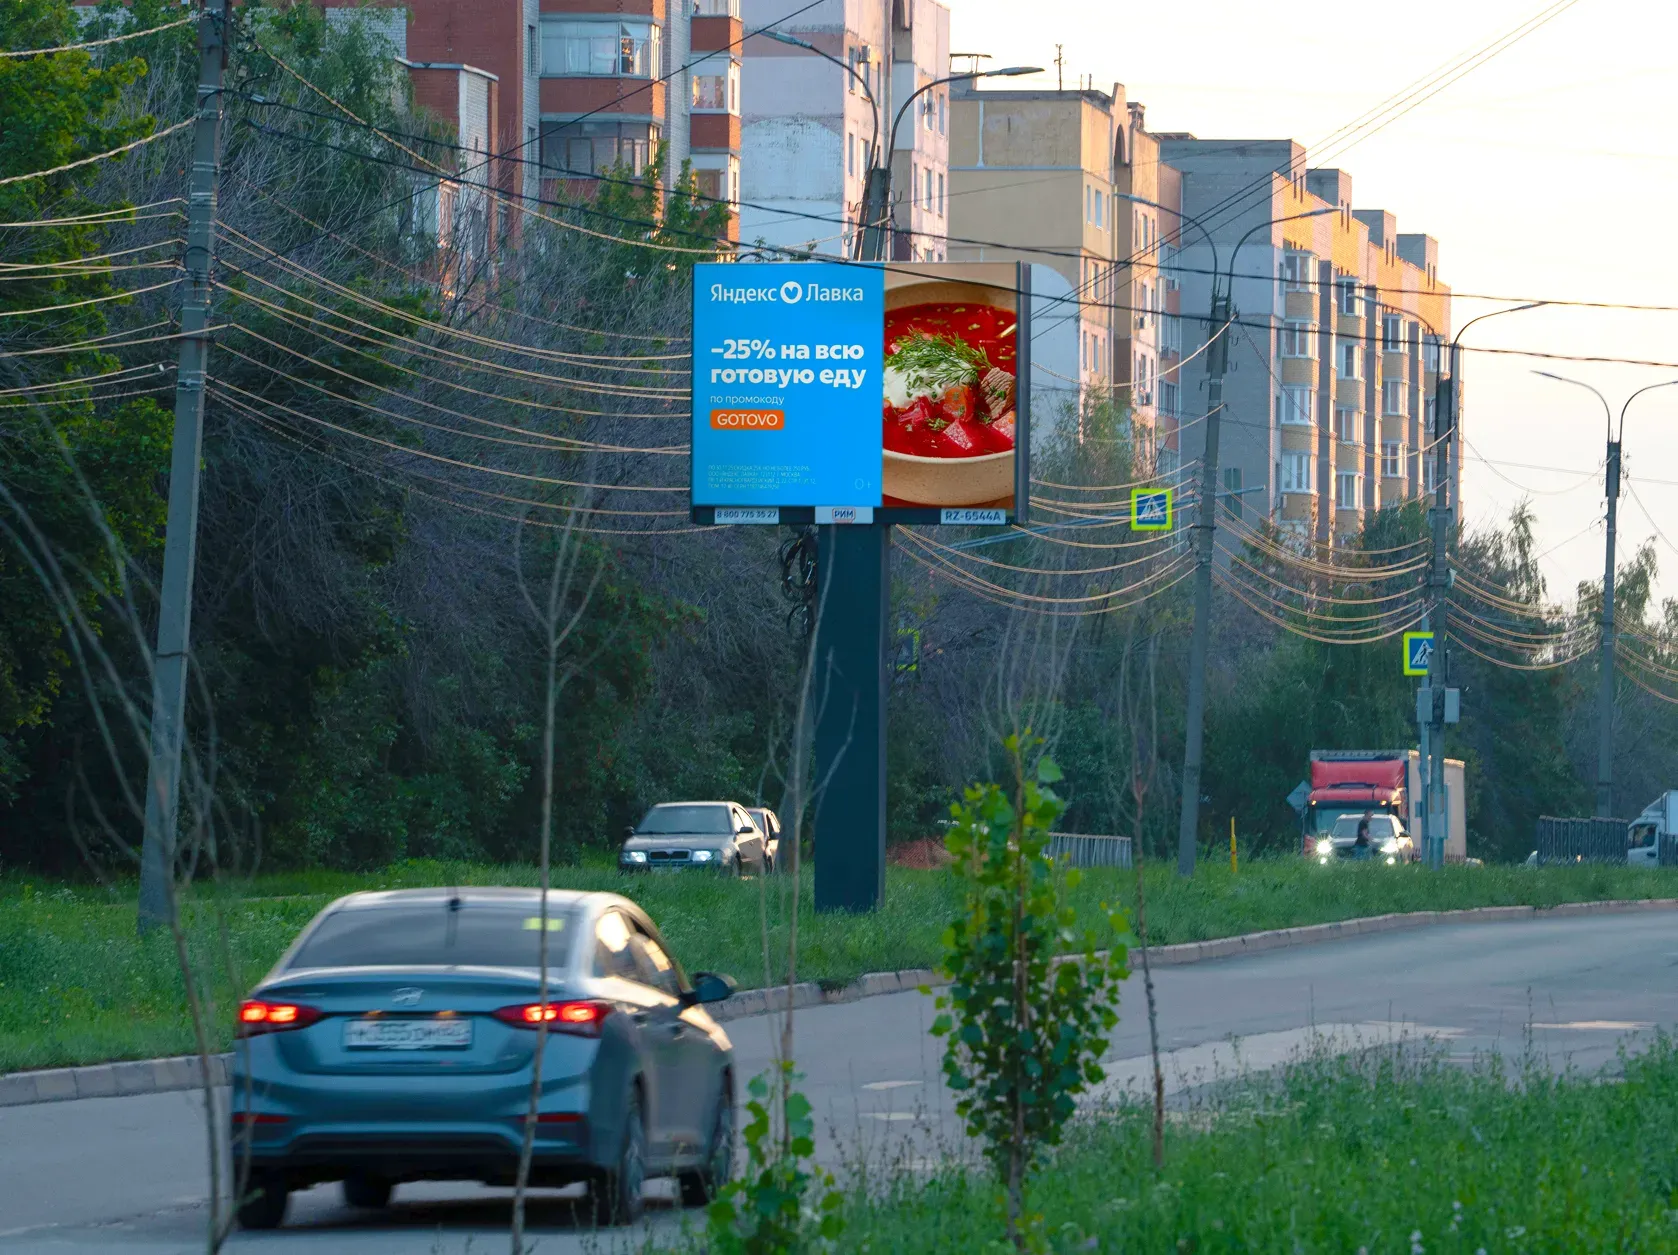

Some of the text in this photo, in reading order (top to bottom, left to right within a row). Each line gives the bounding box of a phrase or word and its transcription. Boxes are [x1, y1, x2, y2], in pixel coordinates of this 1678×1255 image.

[710, 283, 864, 304] Яндекс Лавка
[781, 345, 810, 360] на
[815, 344, 865, 360] всю
[711, 368, 867, 389] готовую еду
[710, 395, 785, 406] по промокоду
[716, 413, 778, 426] GOTOVO
[724, 510, 739, 519] 800
[834, 510, 854, 519] РИМ
